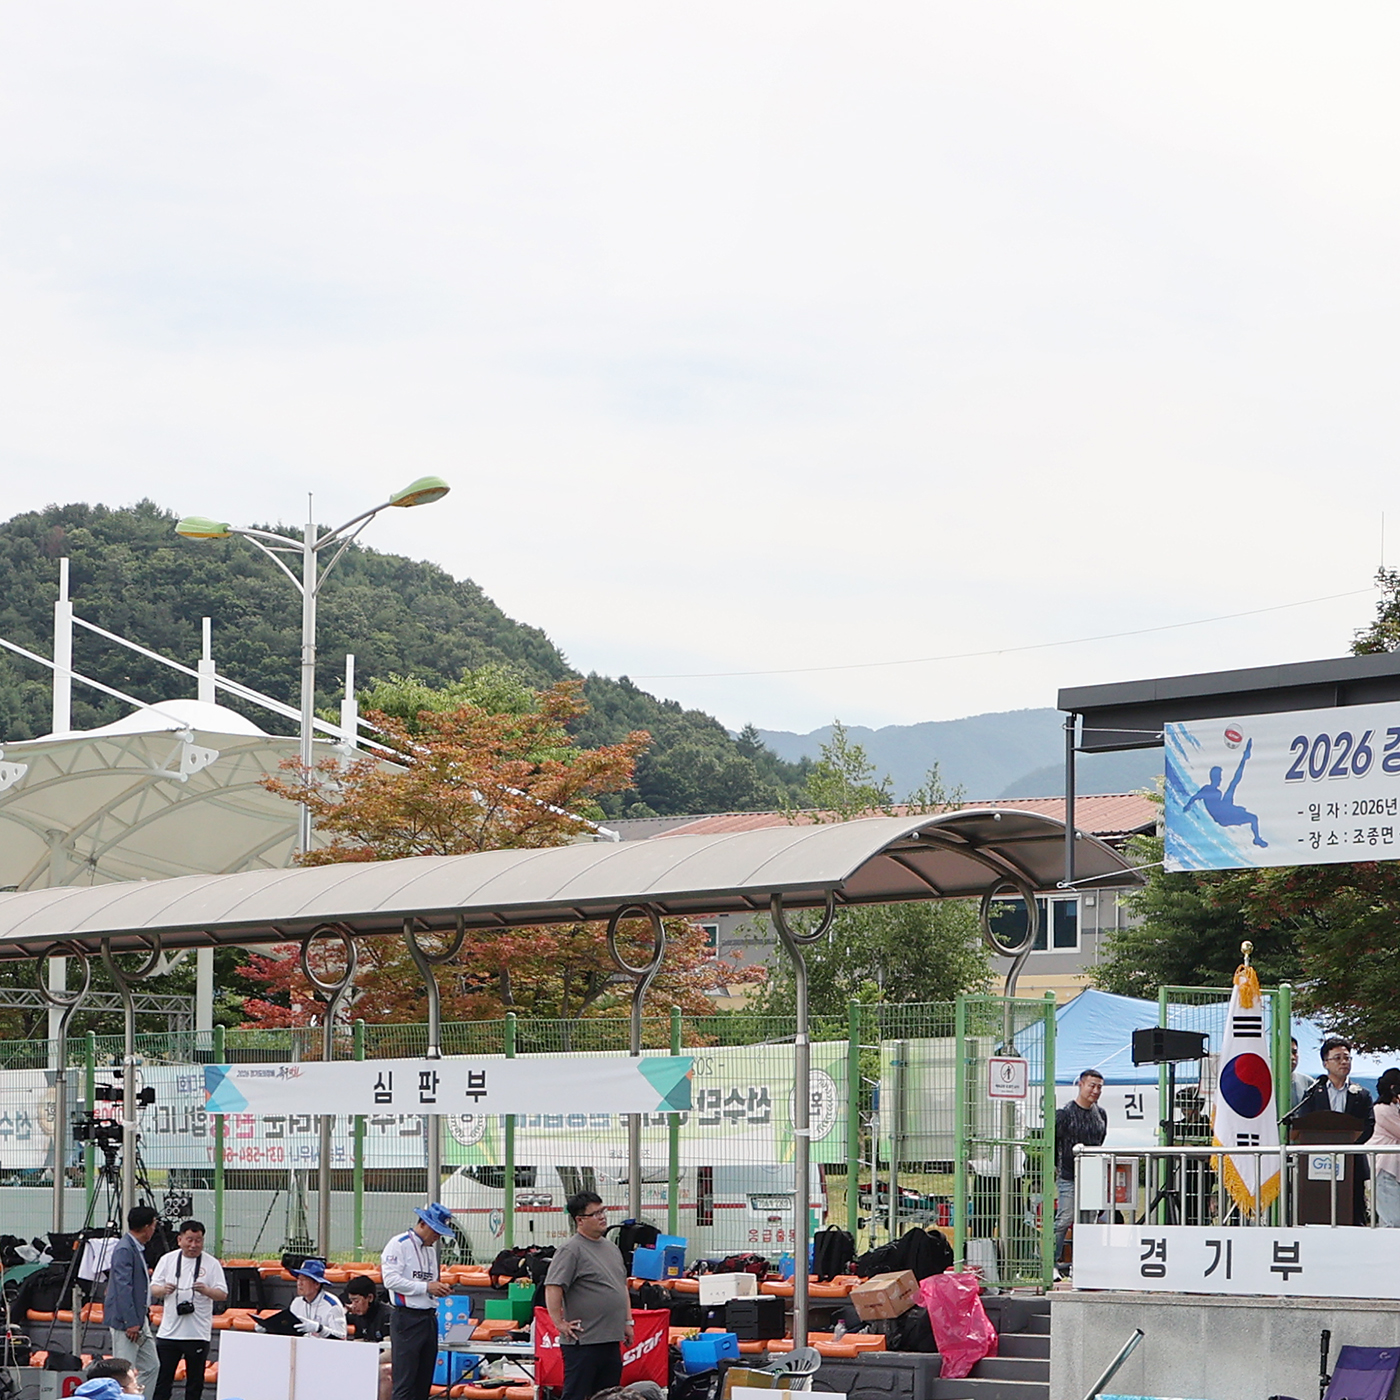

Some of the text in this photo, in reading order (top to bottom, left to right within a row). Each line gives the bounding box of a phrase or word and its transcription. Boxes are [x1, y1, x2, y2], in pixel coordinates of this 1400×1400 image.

[1284, 730, 1375, 782] 2026
[1352, 796, 1398, 816] 2026년
[1352, 826, 1395, 846] 조종면
